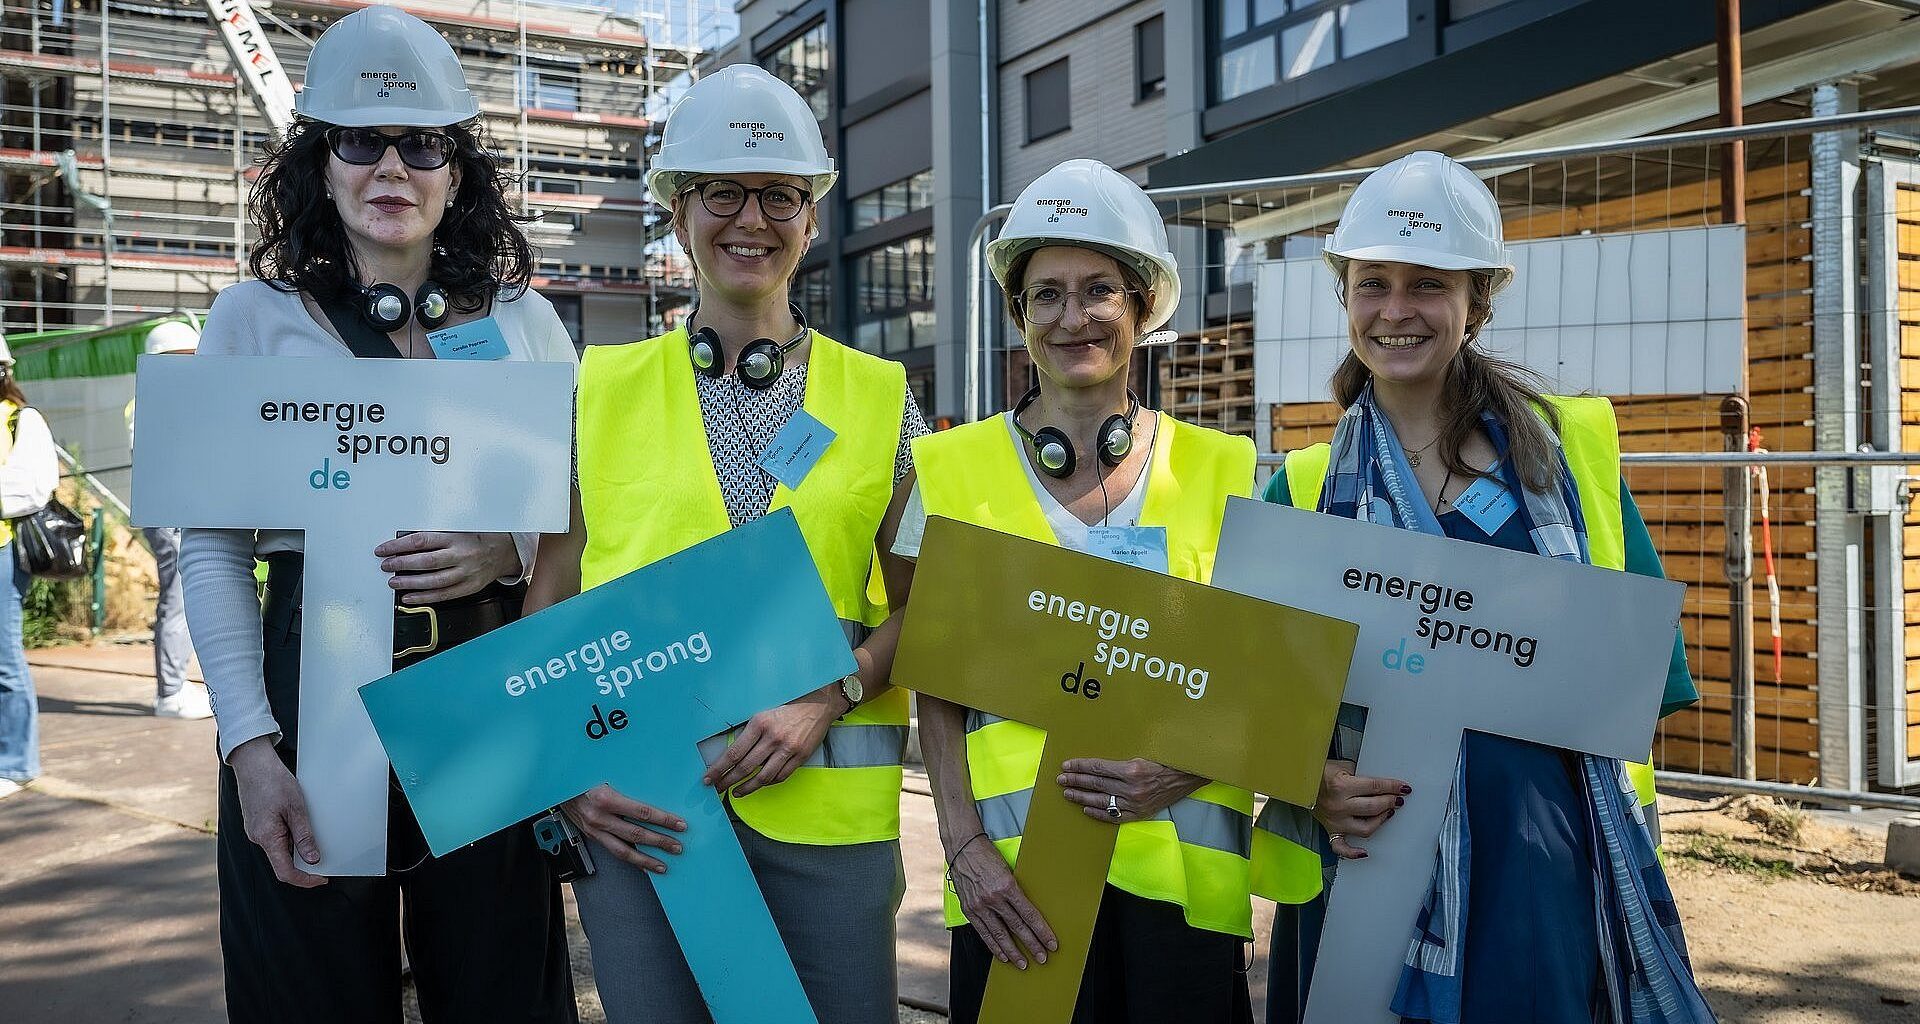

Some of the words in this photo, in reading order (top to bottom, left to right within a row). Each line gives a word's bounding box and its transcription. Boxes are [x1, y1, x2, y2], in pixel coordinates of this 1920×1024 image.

[361, 72, 397, 81] energie
[384, 81, 416, 91] sprong
[377, 88, 389, 97] de
[729, 122, 765, 131] energie
[752, 132, 784, 141] sprong
[745, 138, 757, 148] de
[1037, 199, 1071, 207] energie
[1056, 207, 1088, 216] sprong
[1048, 214, 1059, 222] de
[1388, 210, 1424, 220] energie
[1399, 227, 1411, 236] de
[1408, 221, 1442, 232] sprong
[260, 401, 385, 431] energie
[336, 434, 450, 464] sprong
[309, 457, 350, 489] de
[1343, 568, 1473, 614] energie
[1028, 590, 1149, 640] energie
[1416, 616, 1538, 667] sprong
[505, 630, 631, 697] energie
[595, 631, 712, 698] sprong
[1382, 638, 1425, 674] de
[1060, 661, 1100, 699] de
[1093, 642, 1209, 699] sprong
[585, 704, 629, 740] de
